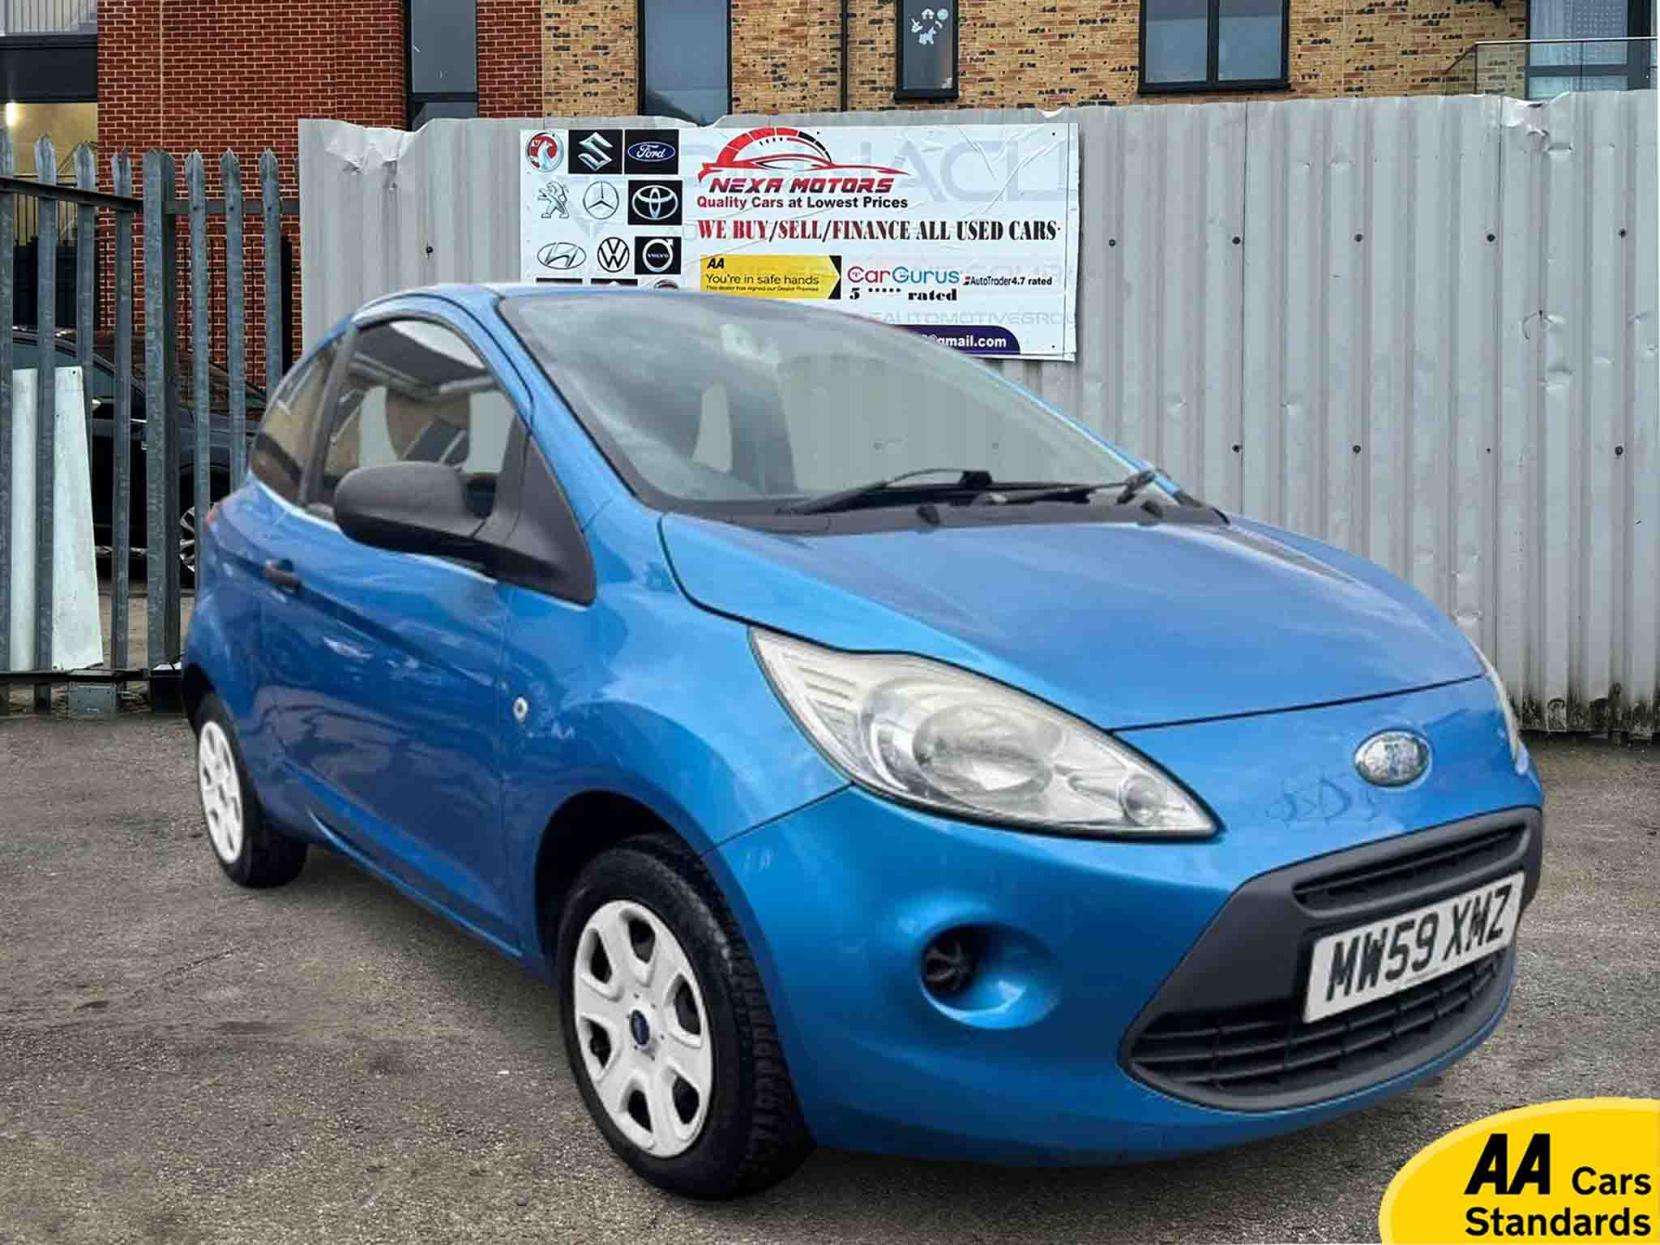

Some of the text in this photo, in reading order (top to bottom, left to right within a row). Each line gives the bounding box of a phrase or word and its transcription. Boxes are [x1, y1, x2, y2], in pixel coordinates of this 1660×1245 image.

[636, 144, 666, 158] Ford
[709, 178, 894, 194] NEXA MOTORS
[697, 196, 908, 208] Quality Cars at Lowest Prices
[698, 219, 1057, 242] WE BUY/SELL/FINANCE ALL USED CARS
[707, 258, 725, 269] AA
[706, 273, 820, 286] You're in safe hands
[847, 266, 961, 284] CarGurus
[1028, 277, 1053, 286] rated
[849, 287, 957, 301] 5 rated
[1326, 884, 1513, 1001] MW59 XMZ
